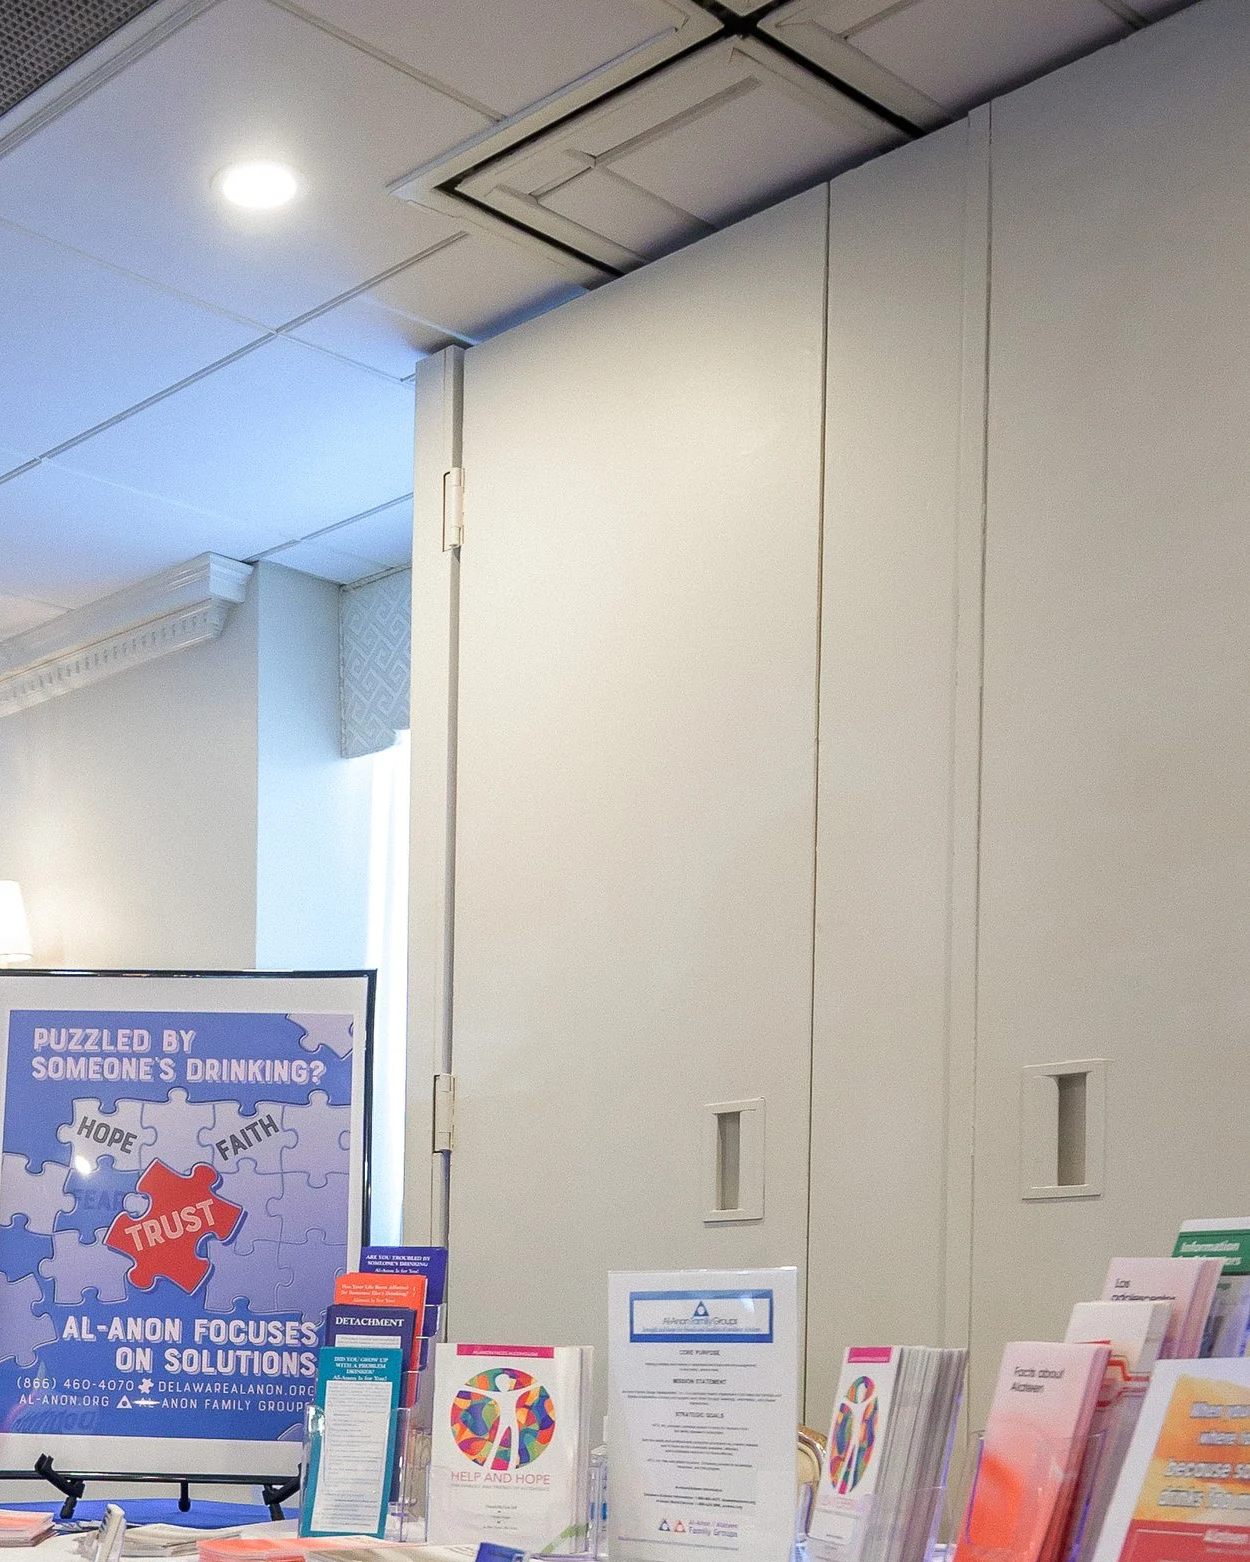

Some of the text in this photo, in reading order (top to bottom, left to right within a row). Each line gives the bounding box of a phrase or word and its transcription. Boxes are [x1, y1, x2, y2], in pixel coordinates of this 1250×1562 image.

[33, 1028, 195, 1054] PUZZLED BY
[32, 1056, 327, 1086] SOMEONE'S DRINKING?
[76, 1116, 138, 1154] HOPE
[216, 1114, 280, 1161] FAITH
[125, 1199, 215, 1252] TRUST
[62, 1315, 319, 1348] AL-ANON FOCUSES
[335, 1316, 405, 1328] DETACHMENT
[115, 1346, 318, 1378] ON SOLUTIONS
[16, 1376, 57, 1390] (866)
[63, 1378, 134, 1391] 460-4070
[19, 1393, 110, 1408] AL-ANON.ORG
[204, 1399, 251, 1411] FAMILY
[450, 1471, 551, 1485] HELP AND HOPE
